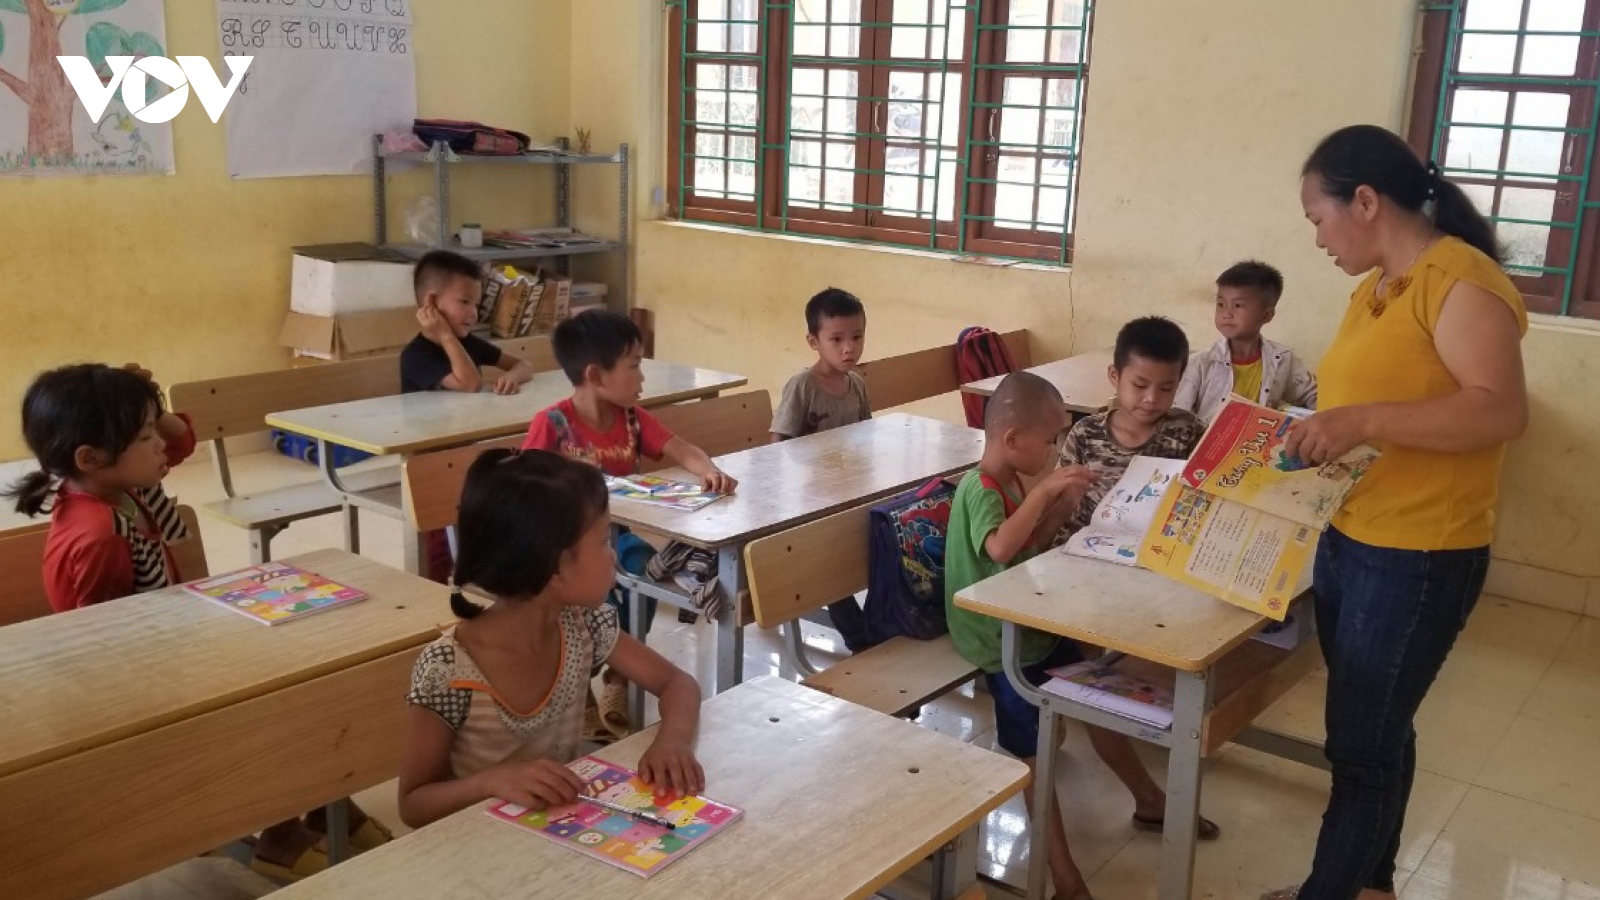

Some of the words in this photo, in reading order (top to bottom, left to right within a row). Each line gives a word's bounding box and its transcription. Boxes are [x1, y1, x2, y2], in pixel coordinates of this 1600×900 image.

[221, 19, 250, 47] R
[251, 19, 271, 48] S
[281, 21, 302, 48] T
[309, 21, 336, 50] U
[363, 25, 385, 51] V
[388, 27, 406, 54] X
